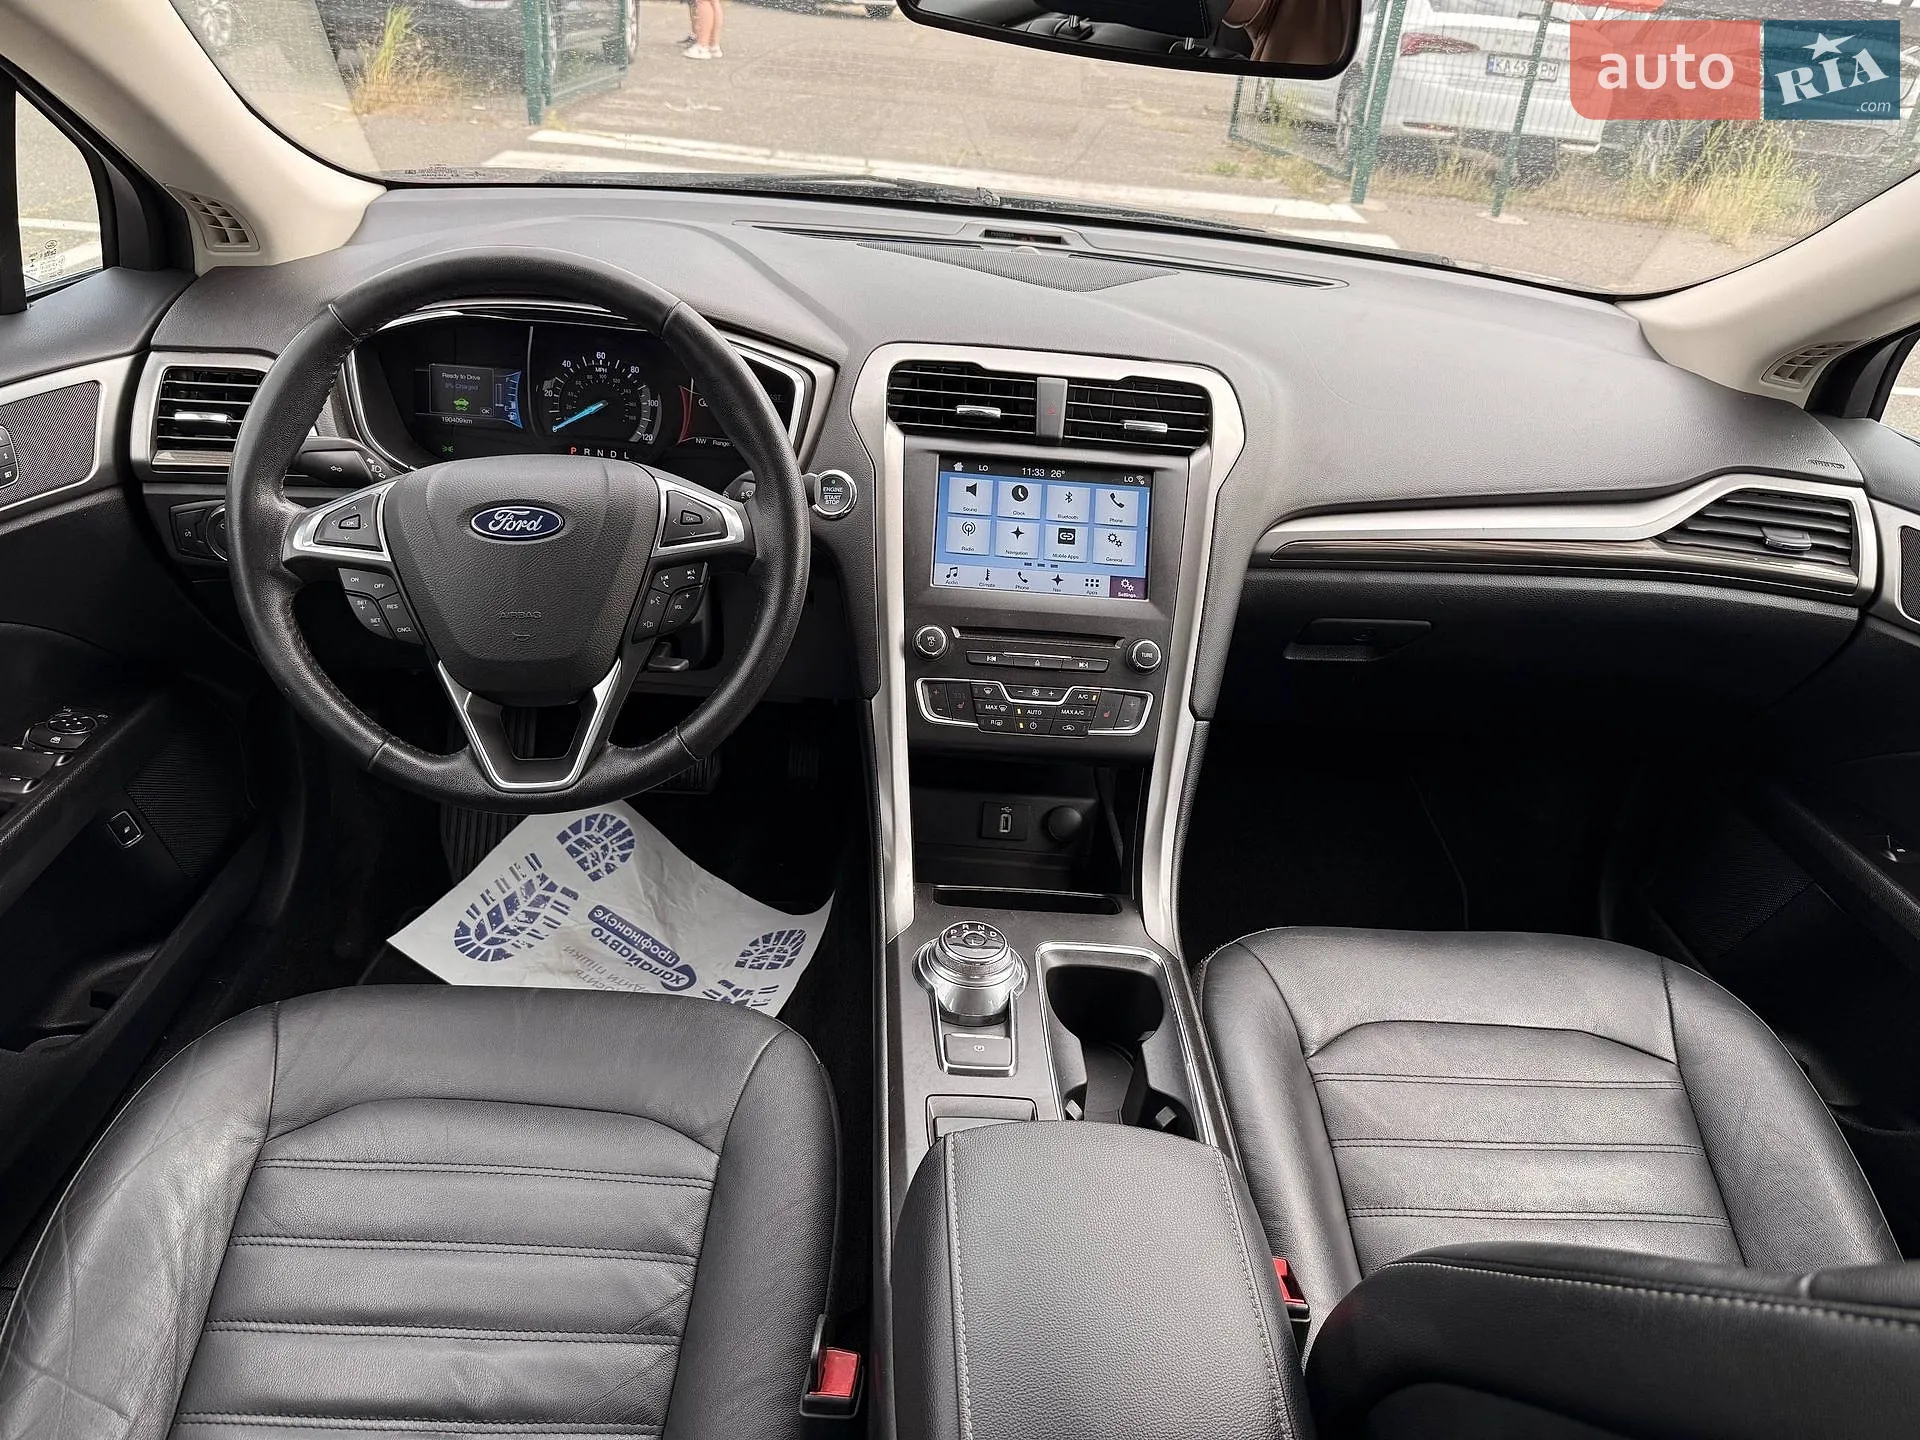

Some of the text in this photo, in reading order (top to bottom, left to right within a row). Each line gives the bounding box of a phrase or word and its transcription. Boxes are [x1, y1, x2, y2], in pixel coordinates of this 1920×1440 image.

[562, 360, 571, 368] 40
[442, 372, 459, 380] Ready
[570, 446, 577, 454] P
[597, 449, 604, 457] N
[978, 464, 989, 472] LO
[1021, 467, 1045, 477] 11:33
[1050, 469, 1066, 478] 26°
[488, 509, 544, 532] Ford
[593, 909, 677, 965] профінансує
[591, 927, 686, 985] хапайавто
